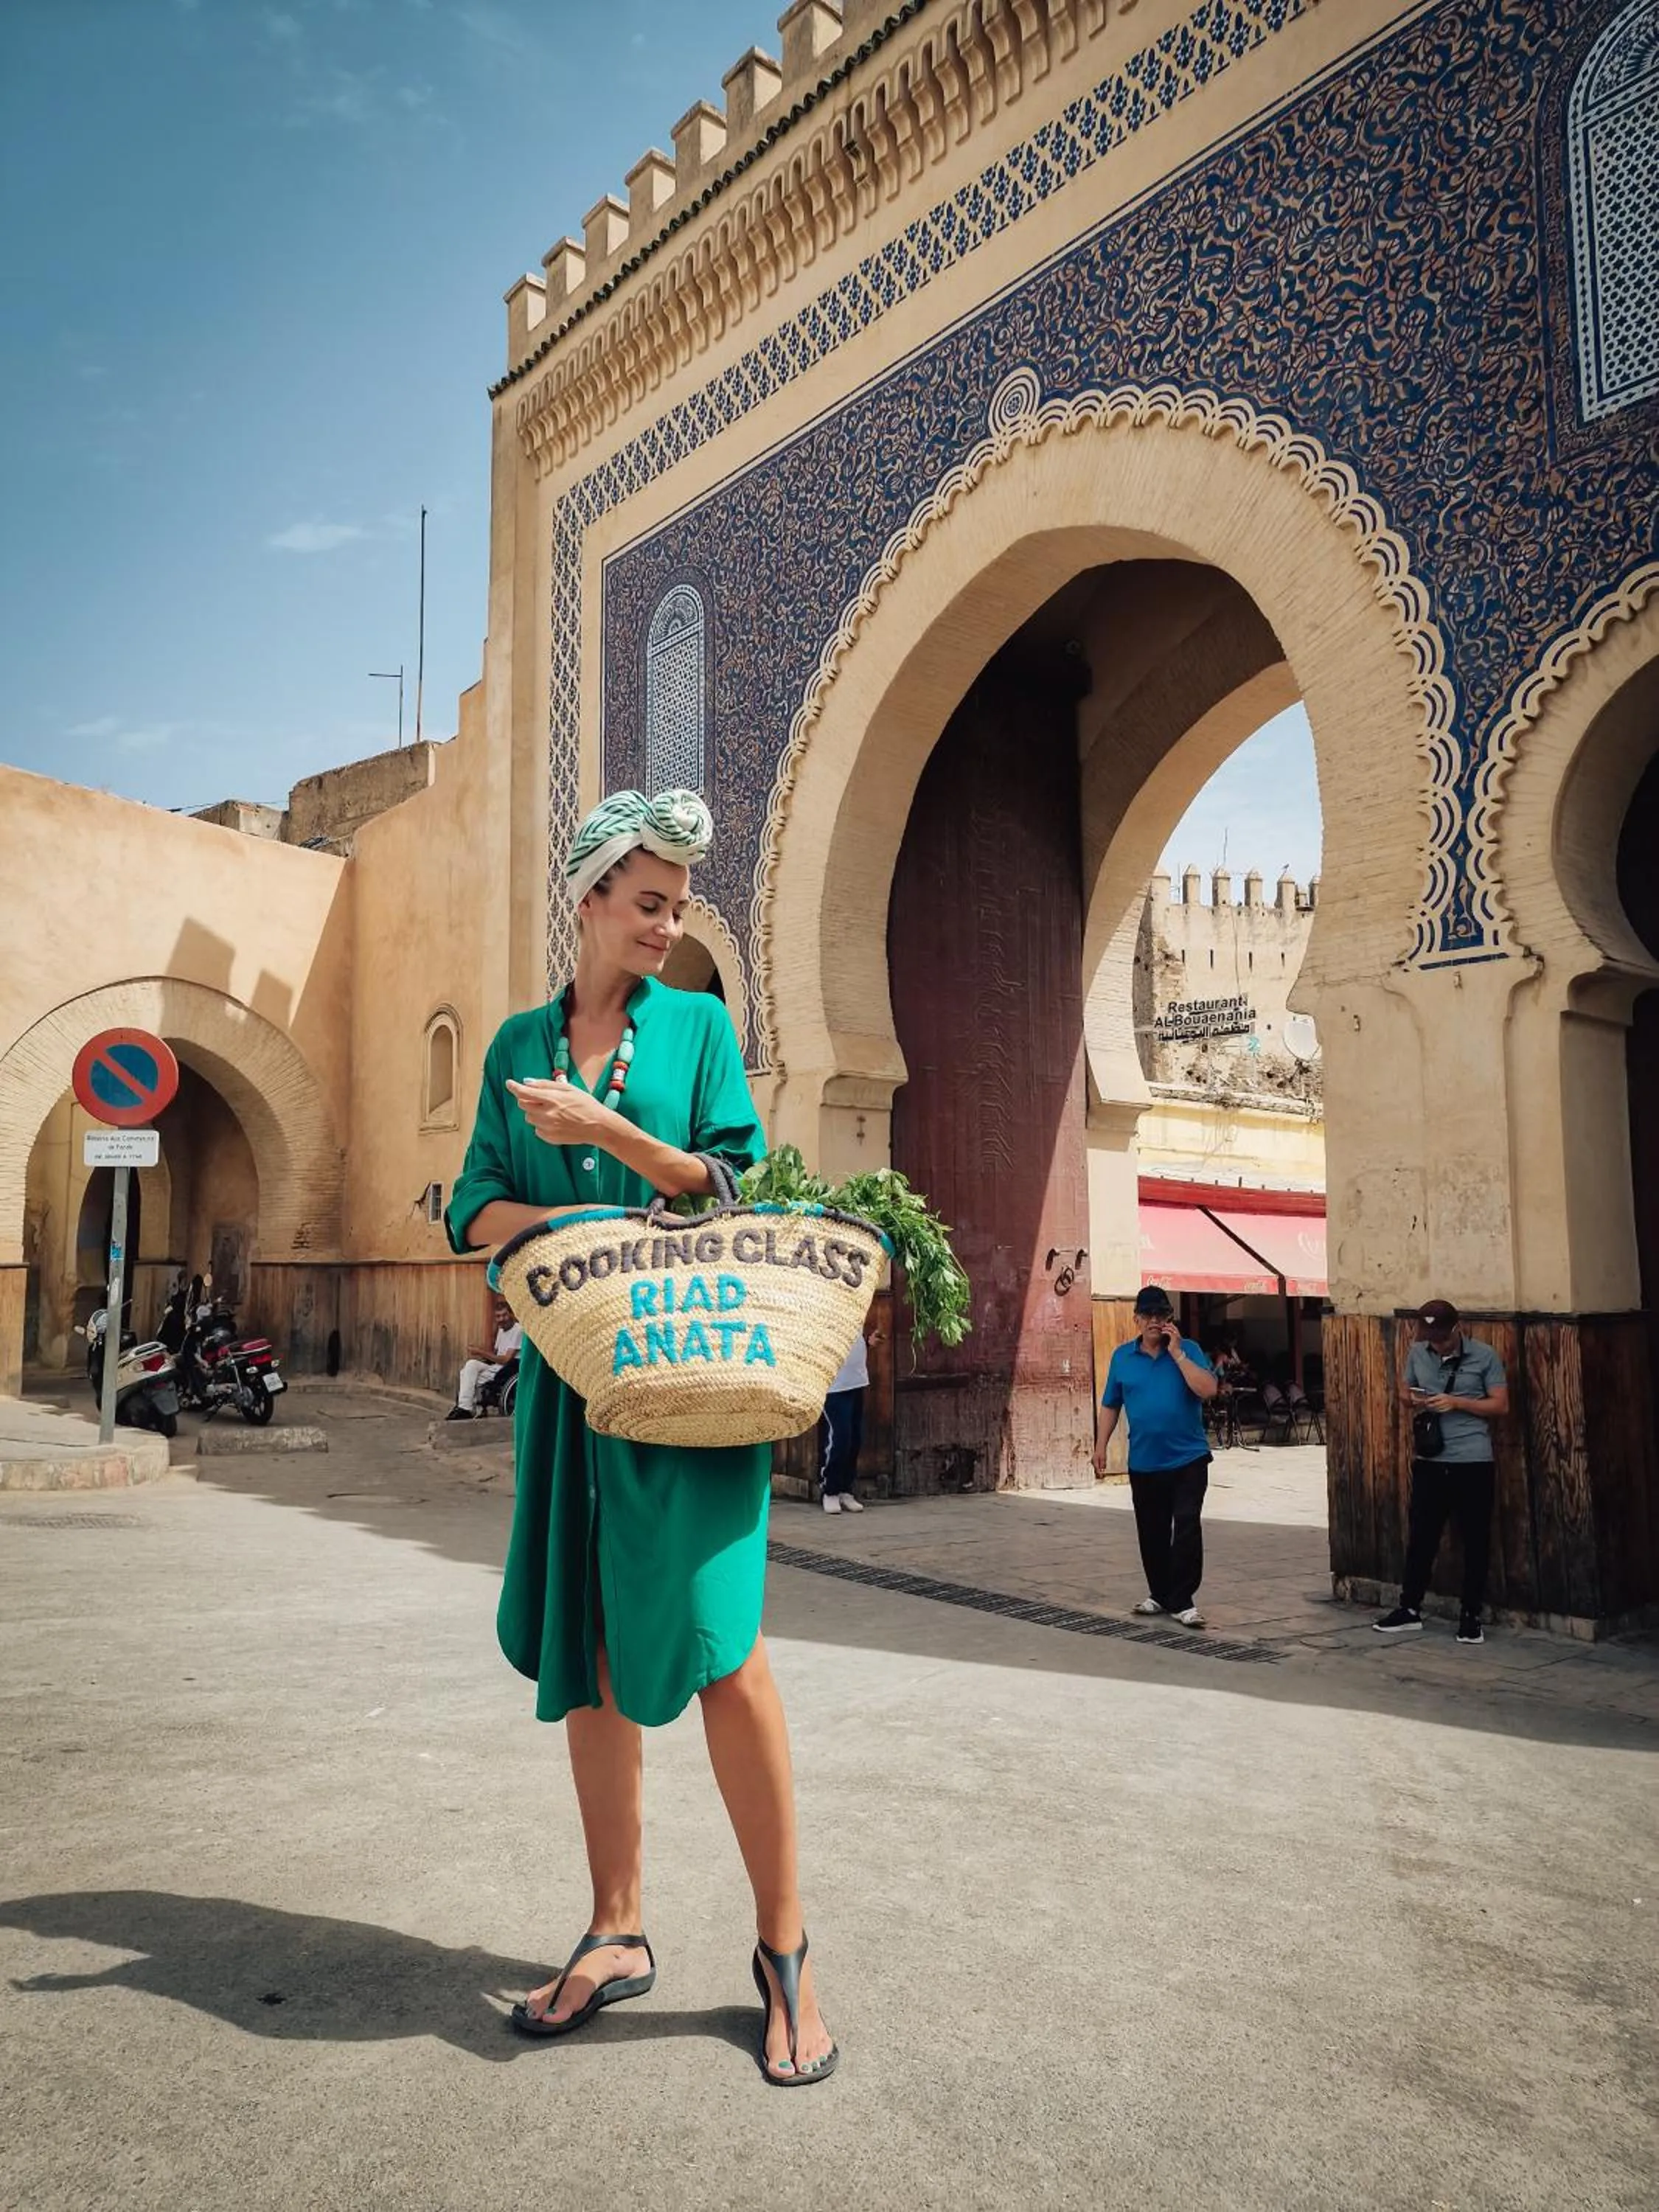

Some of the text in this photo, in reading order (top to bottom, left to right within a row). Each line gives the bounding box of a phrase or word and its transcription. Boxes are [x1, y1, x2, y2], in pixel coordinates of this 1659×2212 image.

[1168, 995, 1243, 1013] Restaurant
[526, 1228, 871, 1307] COOKING CLASS
[630, 1273, 747, 1319] RIAD
[613, 1320, 776, 1376] ANATA
